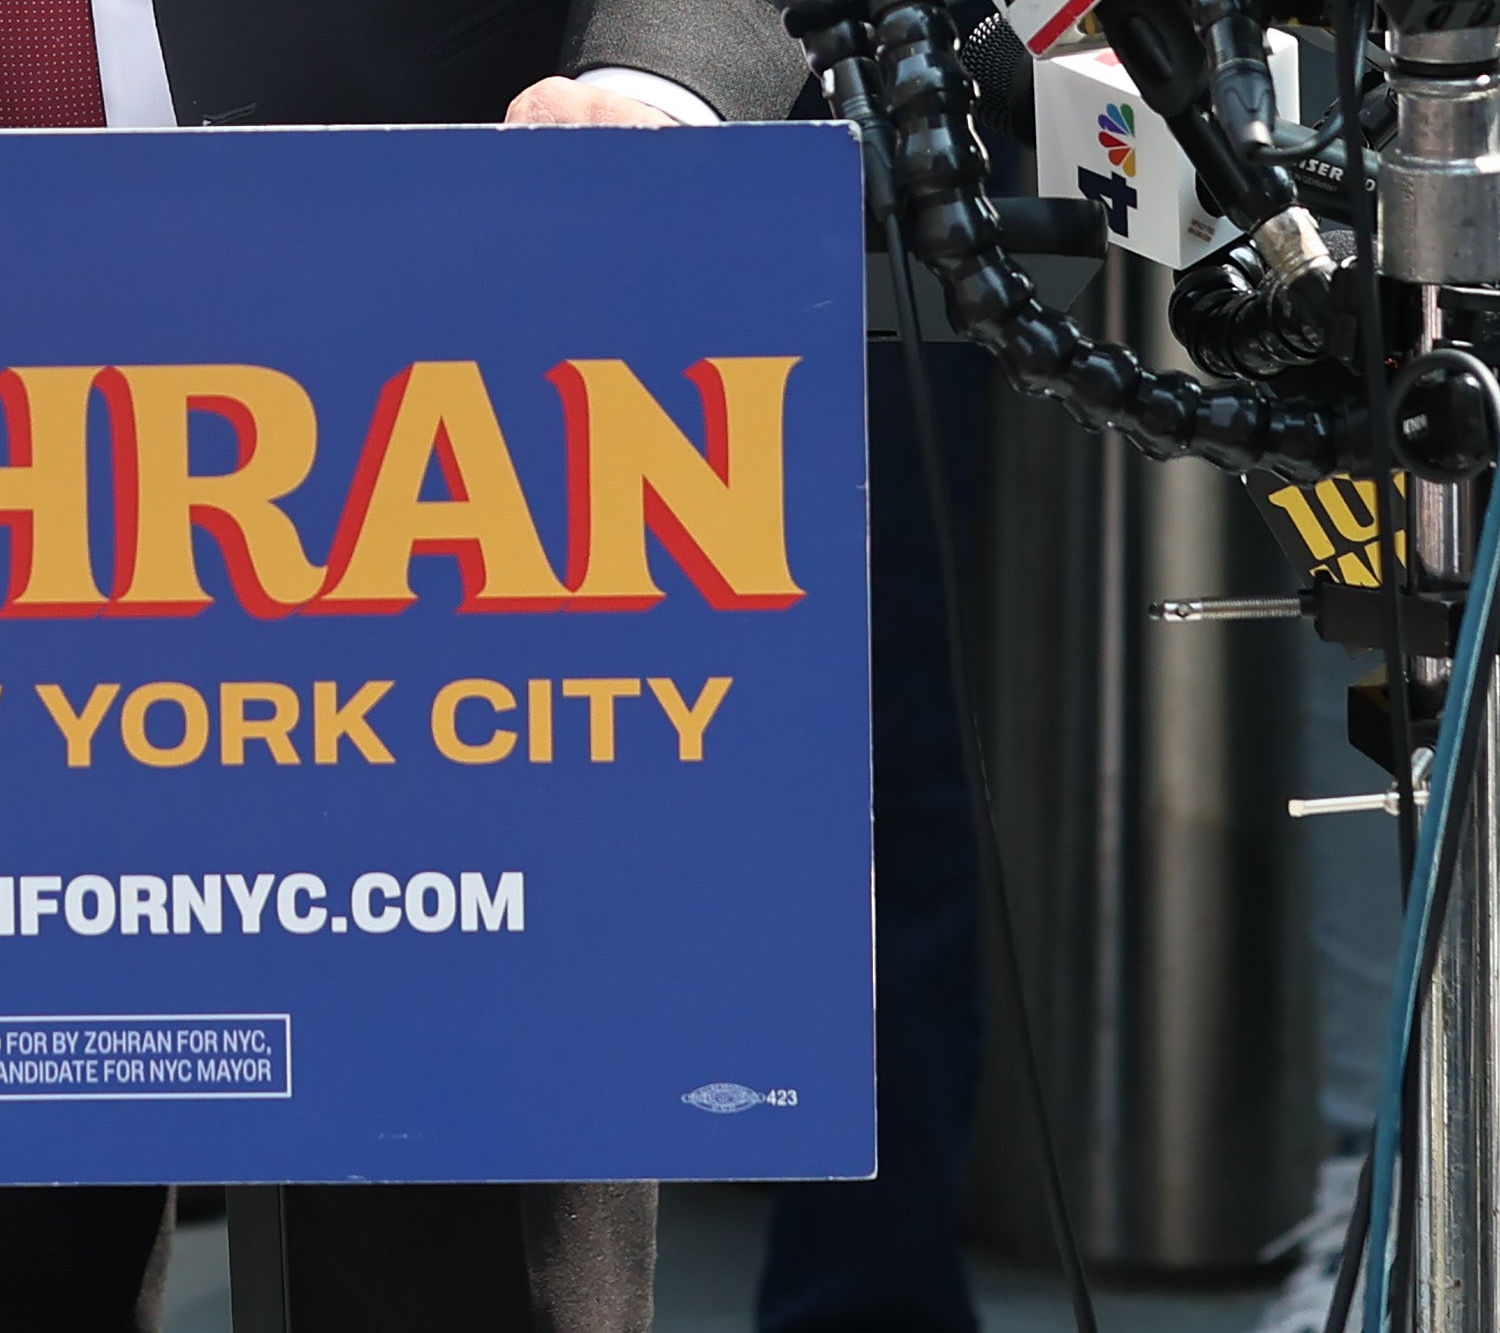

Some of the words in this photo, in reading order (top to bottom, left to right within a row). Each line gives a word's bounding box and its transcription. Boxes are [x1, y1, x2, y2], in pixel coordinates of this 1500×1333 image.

[1077, 165, 1138, 239] 4
[34, 680, 396, 768] YORK
[429, 675, 735, 763] CITY
[6, 1031, 47, 1055] FOR
[52, 1030, 80, 1055] BY
[84, 1030, 172, 1054] ZOHRAN
[177, 1029, 218, 1054] FOR
[223, 1029, 272, 1056] NYC,
[104, 1059, 145, 1083] FOR
[150, 1059, 192, 1083] NYC
[198, 1058, 272, 1083] MAYOR
[766, 1089, 798, 1106] 423
